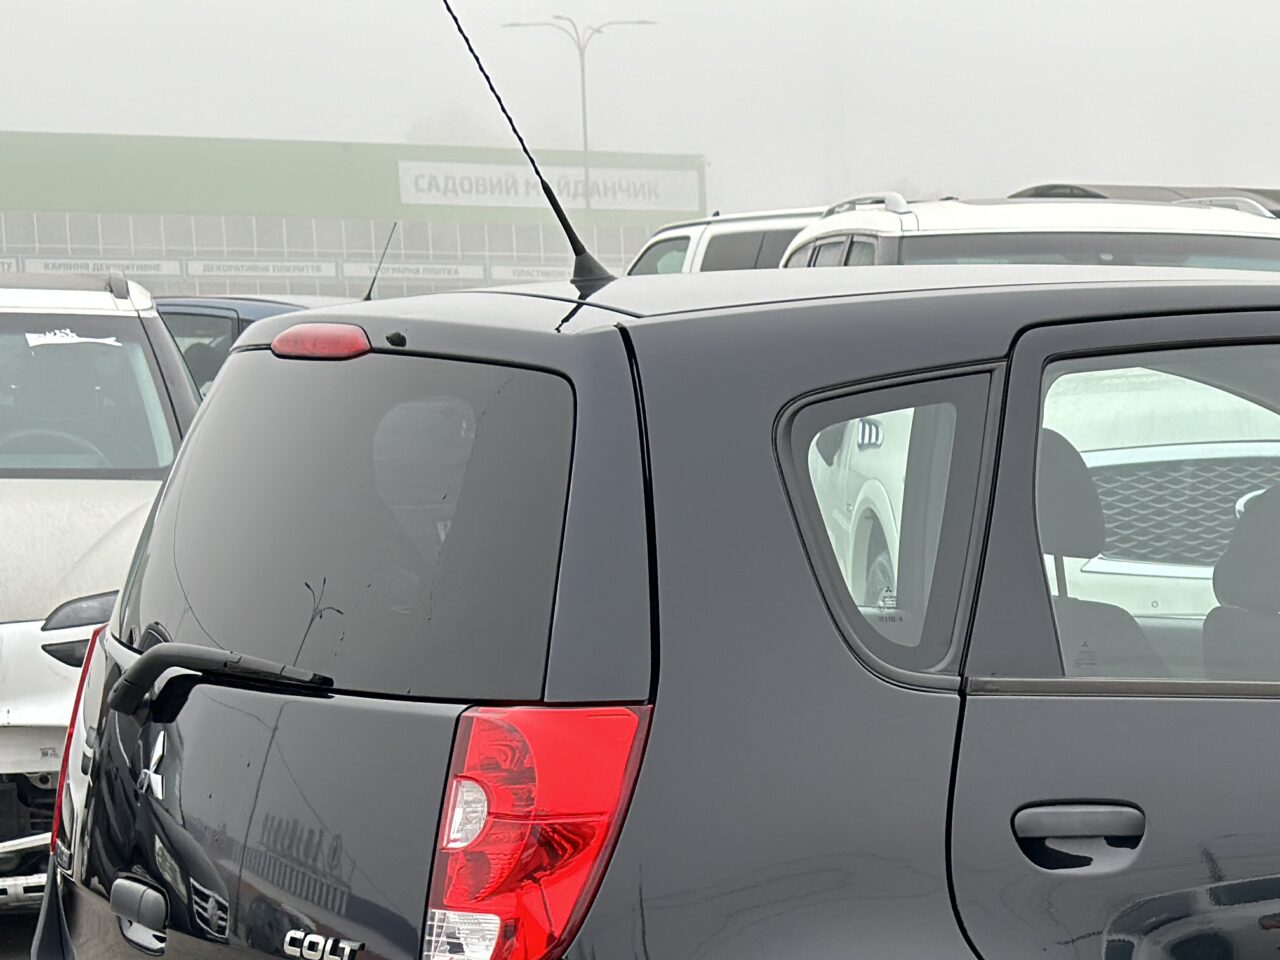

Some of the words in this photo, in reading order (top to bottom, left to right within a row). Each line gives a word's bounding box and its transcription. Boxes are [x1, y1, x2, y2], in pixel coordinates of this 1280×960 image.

[414, 173, 519, 196] САДОВИЙ
[524, 175, 661, 200] МЙДАНЧИК
[368, 265, 418, 274] ТОТУАРНА
